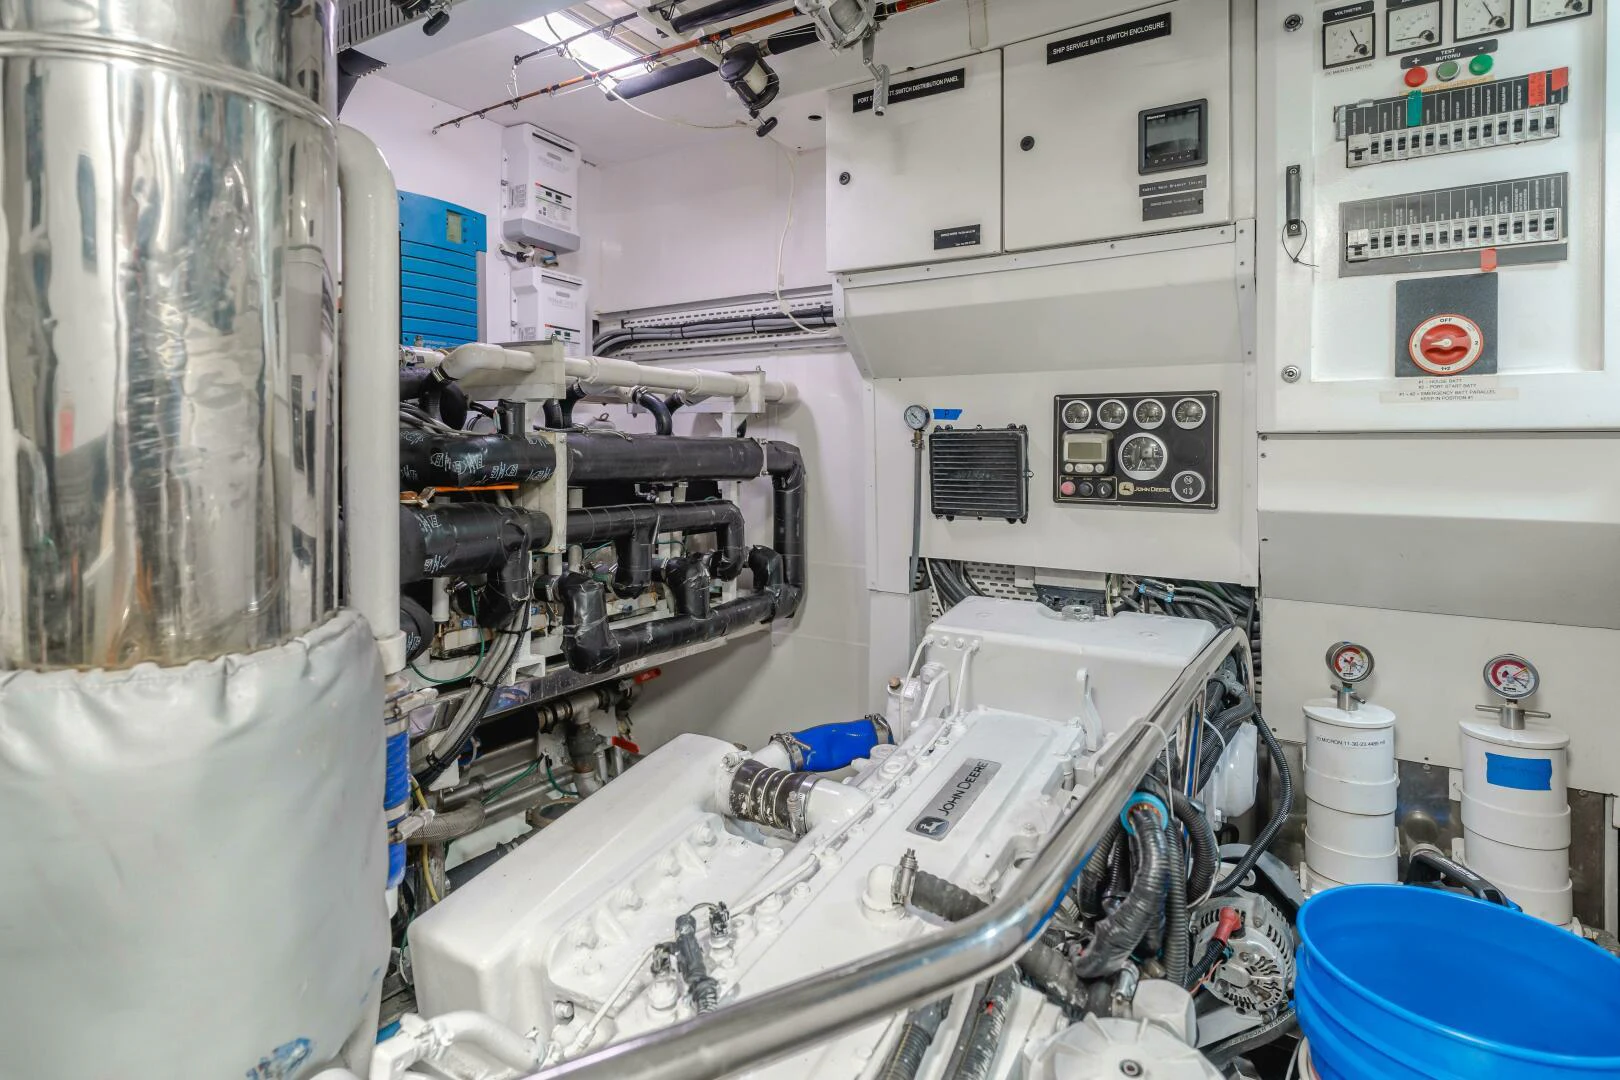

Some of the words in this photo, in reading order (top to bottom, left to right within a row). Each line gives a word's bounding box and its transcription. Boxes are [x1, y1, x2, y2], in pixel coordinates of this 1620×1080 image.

[1052, 46, 1065, 55] SHIP
[1066, 40, 1090, 52] SERVICE
[1090, 36, 1106, 46] BATT.
[1106, 30, 1129, 42] SWITCH
[1129, 21, 1166, 36] ENCLOSURE
[857, 97, 869, 105] PORT
[912, 79, 944, 91] DISTRIBUTION
[943, 75, 960, 85] PANEL
[1321, 737, 1343, 745] MICRON
[937, 789, 966, 817] JOHN
[956, 761, 989, 790] DEERE
